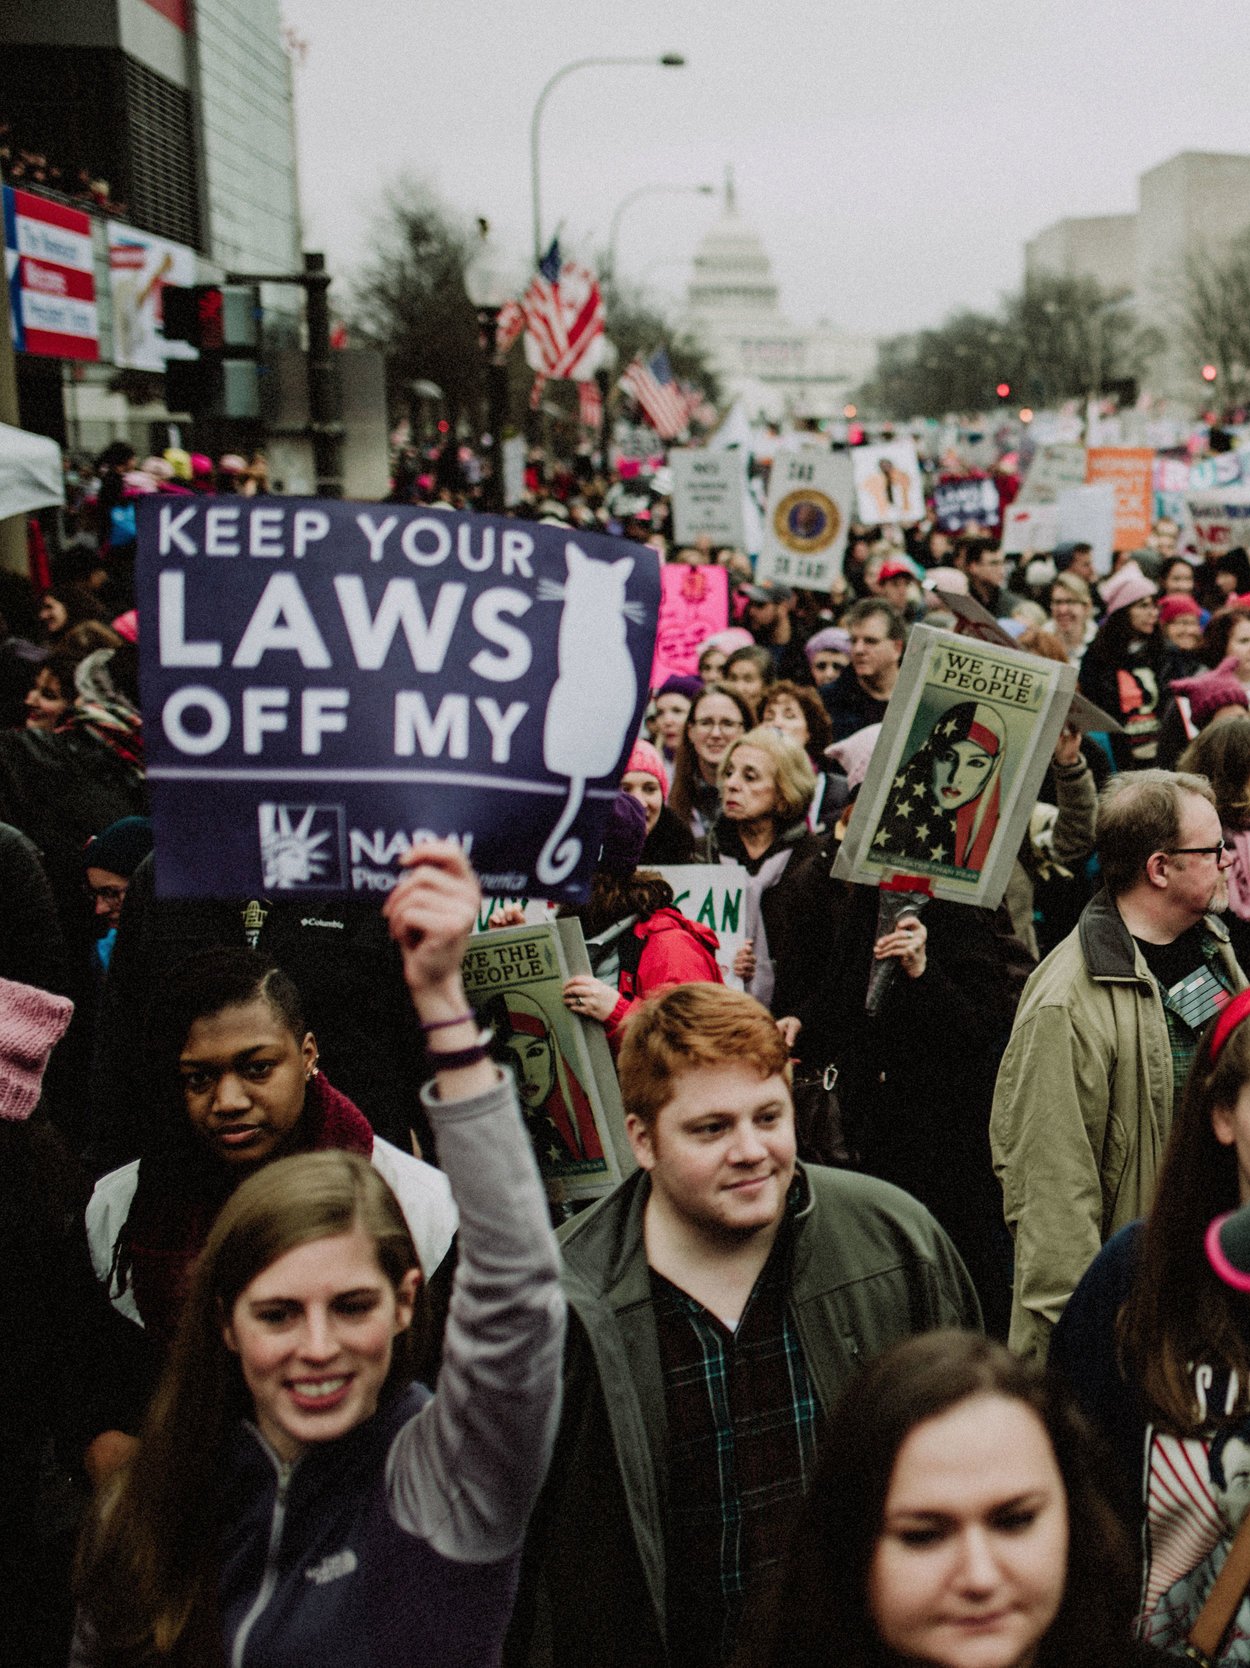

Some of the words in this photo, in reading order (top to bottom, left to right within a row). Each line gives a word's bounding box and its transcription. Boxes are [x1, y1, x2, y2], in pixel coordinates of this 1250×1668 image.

[158, 505, 331, 558] KEEP
[357, 513, 534, 578] YOUR
[158, 568, 533, 683] LAWS
[941, 668, 1030, 705] PEOPLE
[948, 652, 983, 674] WE
[990, 664, 1034, 690] THE
[161, 685, 350, 756] OFF
[394, 690, 530, 764] MY
[497, 942, 540, 964] THE
